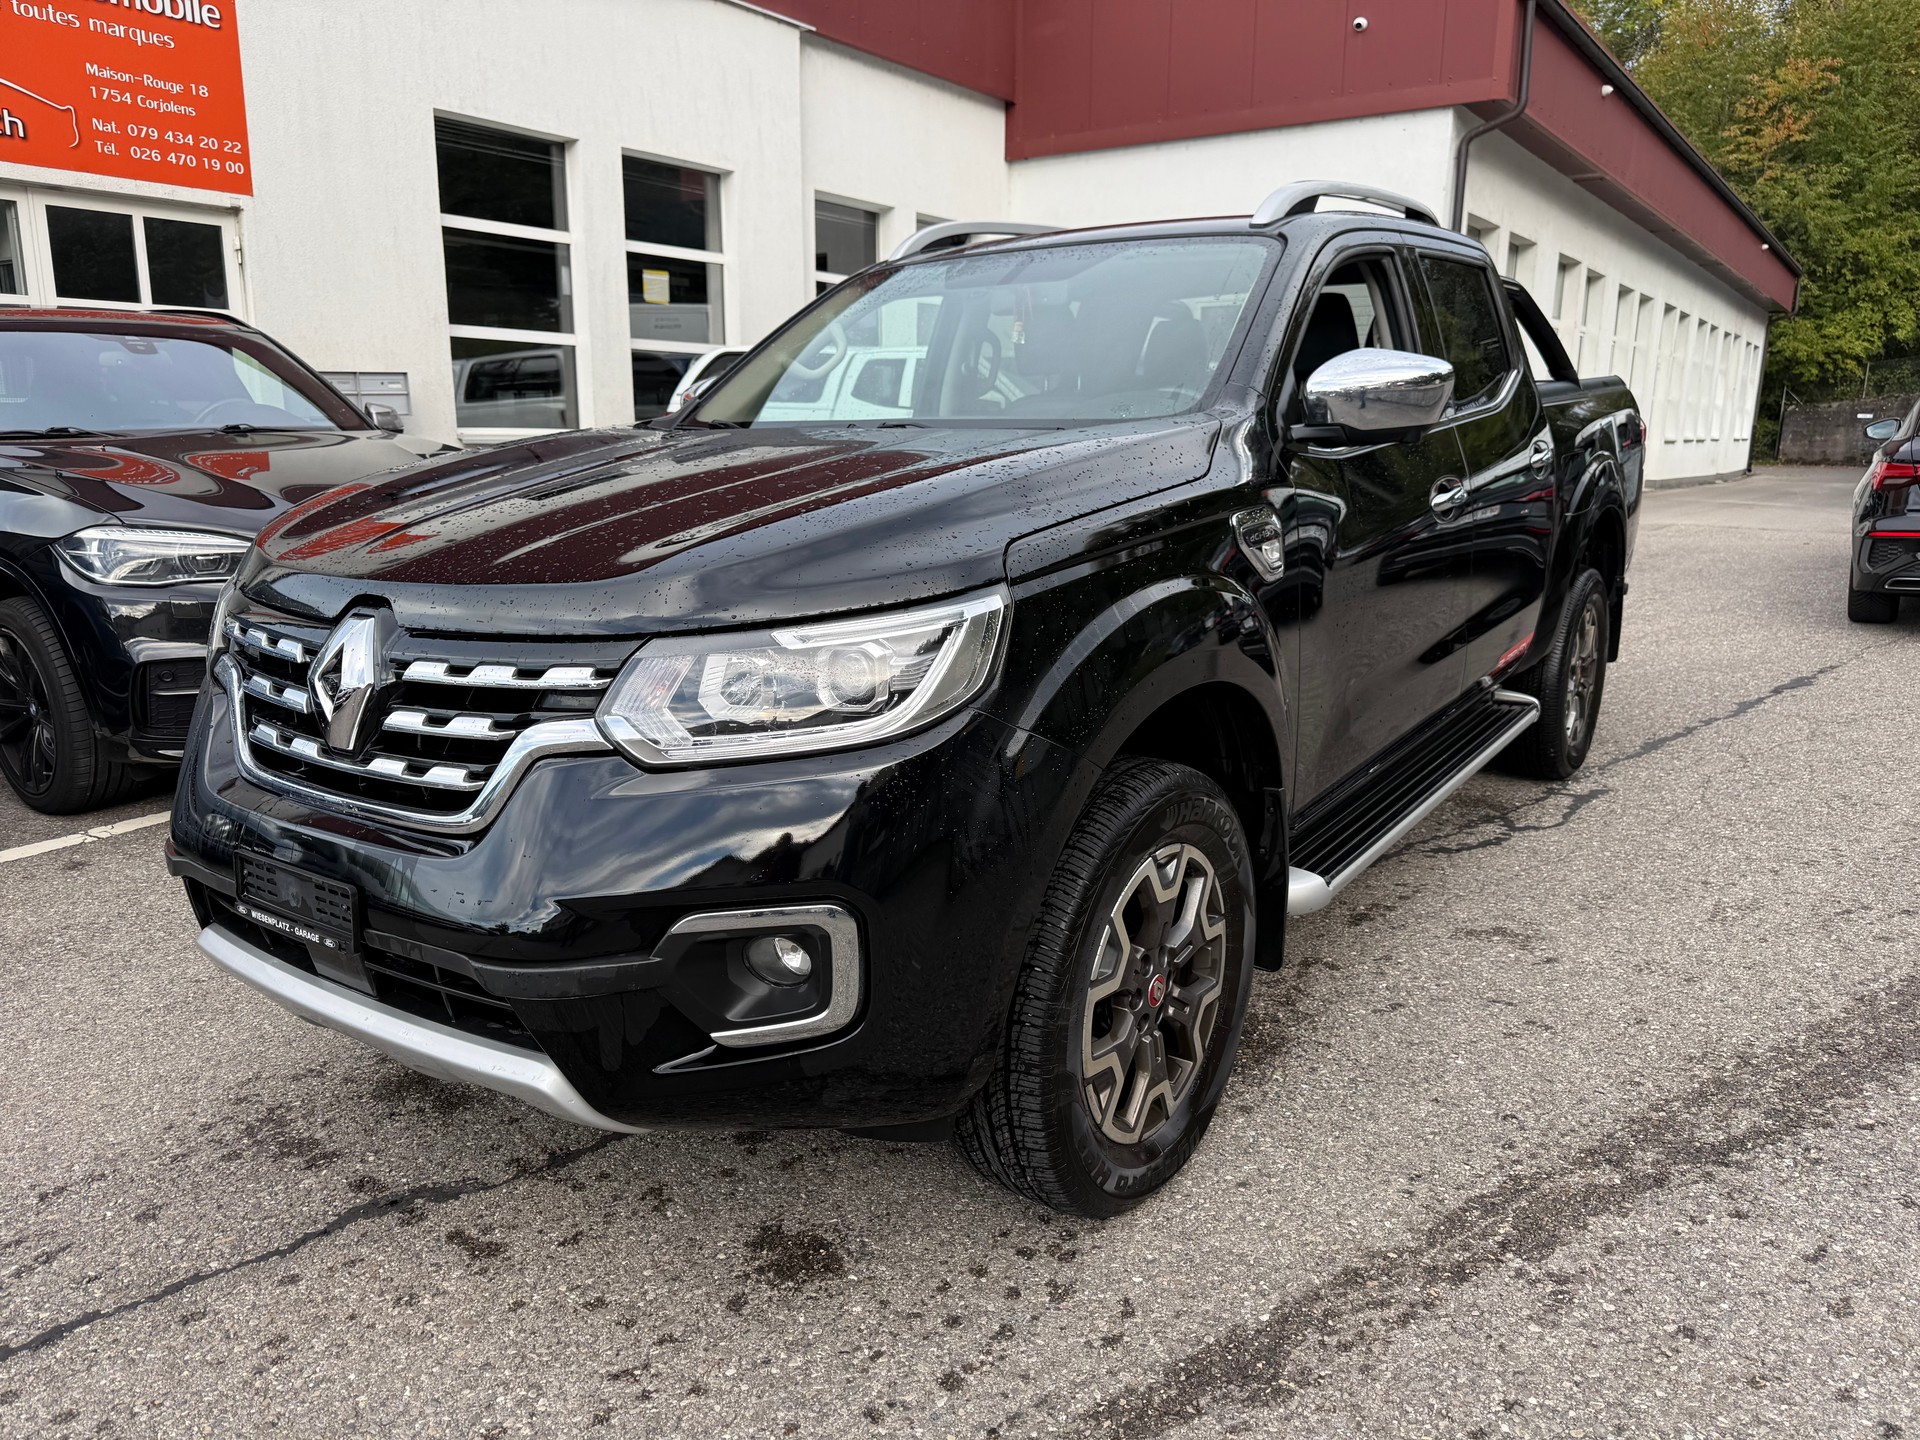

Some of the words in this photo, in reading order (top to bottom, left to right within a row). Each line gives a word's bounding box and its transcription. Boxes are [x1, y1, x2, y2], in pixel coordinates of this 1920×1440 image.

[10, 0, 80, 28] toutes
[88, 17, 175, 49] marques
[85, 62, 184, 95] Maison-Rouge
[189, 83, 209, 98] 18
[89, 86, 132, 105] 1754
[137, 95, 197, 117] Corjolens
[0, 108, 25, 138] h
[92, 117, 121, 135] Nat.
[127, 124, 159, 140] 079
[164, 131, 194, 146] 434
[199, 136, 219, 150] 20
[223, 140, 242, 154] 22
[94, 140, 120, 157] Tél.
[130, 146, 161, 163] 026
[166, 152, 197, 168] 470
[202, 157, 221, 171] 19
[225, 161, 245, 175] 00
[250, 909, 290, 932] WIESENPLATZ
[294, 927, 320, 943] GARAGE
